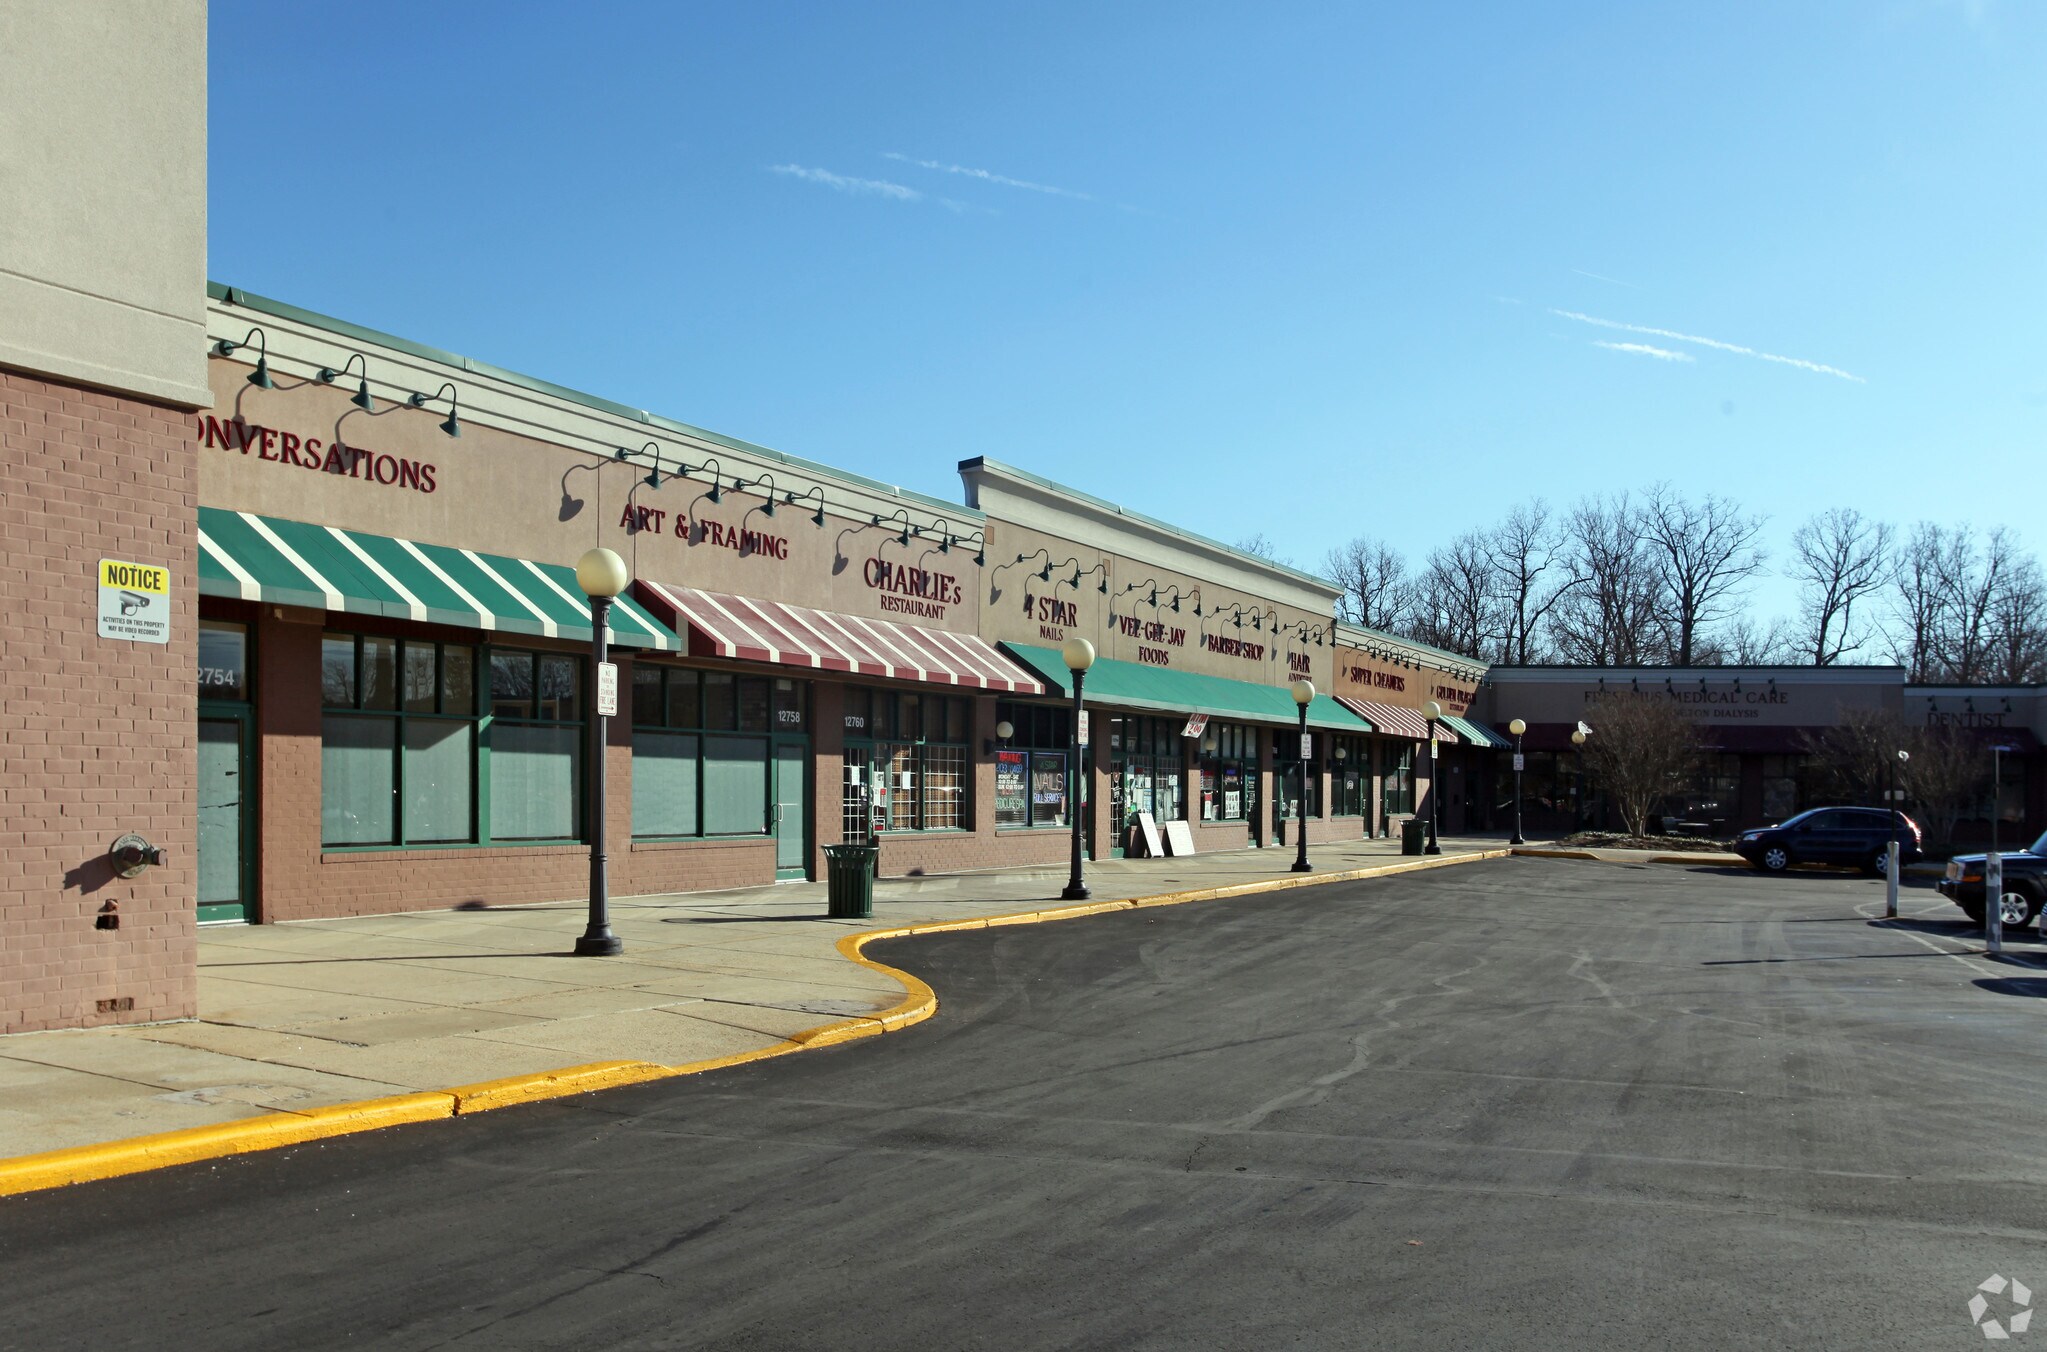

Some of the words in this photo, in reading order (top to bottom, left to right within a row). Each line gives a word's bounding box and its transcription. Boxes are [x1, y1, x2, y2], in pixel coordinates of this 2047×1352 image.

[198, 415, 437, 494] NVERSATIONS
[619, 503, 666, 534] ART
[674, 513, 690, 539] &
[699, 519, 788, 560] FRAMING
[107, 564, 161, 590] NOTICE
[880, 595, 945, 620] RESTAURANT
[1025, 593, 1034, 619] 4
[1038, 596, 1078, 628] STAR
[102, 616, 126, 625] ACTIVITIES
[133, 619, 144, 627] THIS
[143, 620, 166, 629] PROPERTY
[118, 626, 125, 634] BE
[124, 627, 138, 635] VIDEO
[137, 629, 161, 637] RECORDED
[1039, 624, 1064, 642] NAILS
[1119, 614, 1186, 647] VEE-GEE-JAY
[1138, 645, 1169, 666] FOODS
[1207, 633, 1242, 657] BARBER
[1242, 641, 1265, 662] SHOP
[1290, 652, 1311, 674] HAIR
[1350, 666, 1373, 686] SUPER
[1373, 671, 1405, 693] CLEANERS
[1669, 691, 1739, 706] MEDICAL
[1745, 691, 1789, 705] CARE
[778, 710, 800, 723] 12758
[844, 716, 864, 728] 12760
[1713, 709, 1760, 719] DIALYSIS
[1926, 712, 2007, 729] DENTIST
[1034, 773, 1064, 791] NAILS
